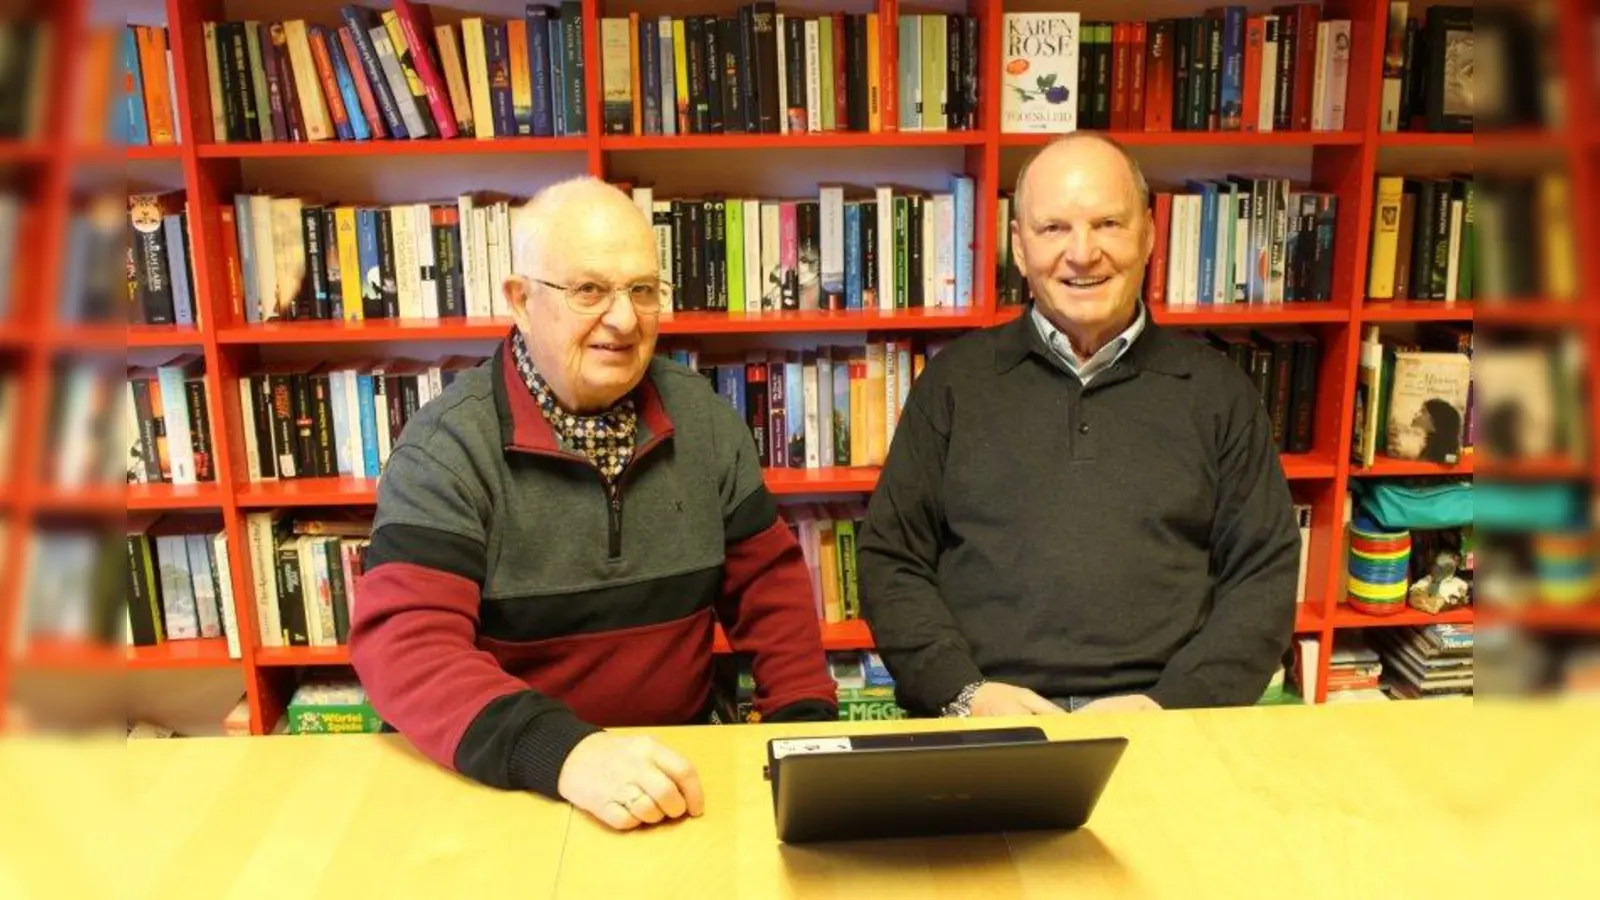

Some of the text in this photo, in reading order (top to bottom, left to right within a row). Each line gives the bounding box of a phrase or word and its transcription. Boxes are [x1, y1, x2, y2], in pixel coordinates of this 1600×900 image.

[1009, 19, 1072, 35] KAREN
[1008, 36, 1073, 57] ROSE
[149, 233, 162, 291] SARAH LARK
